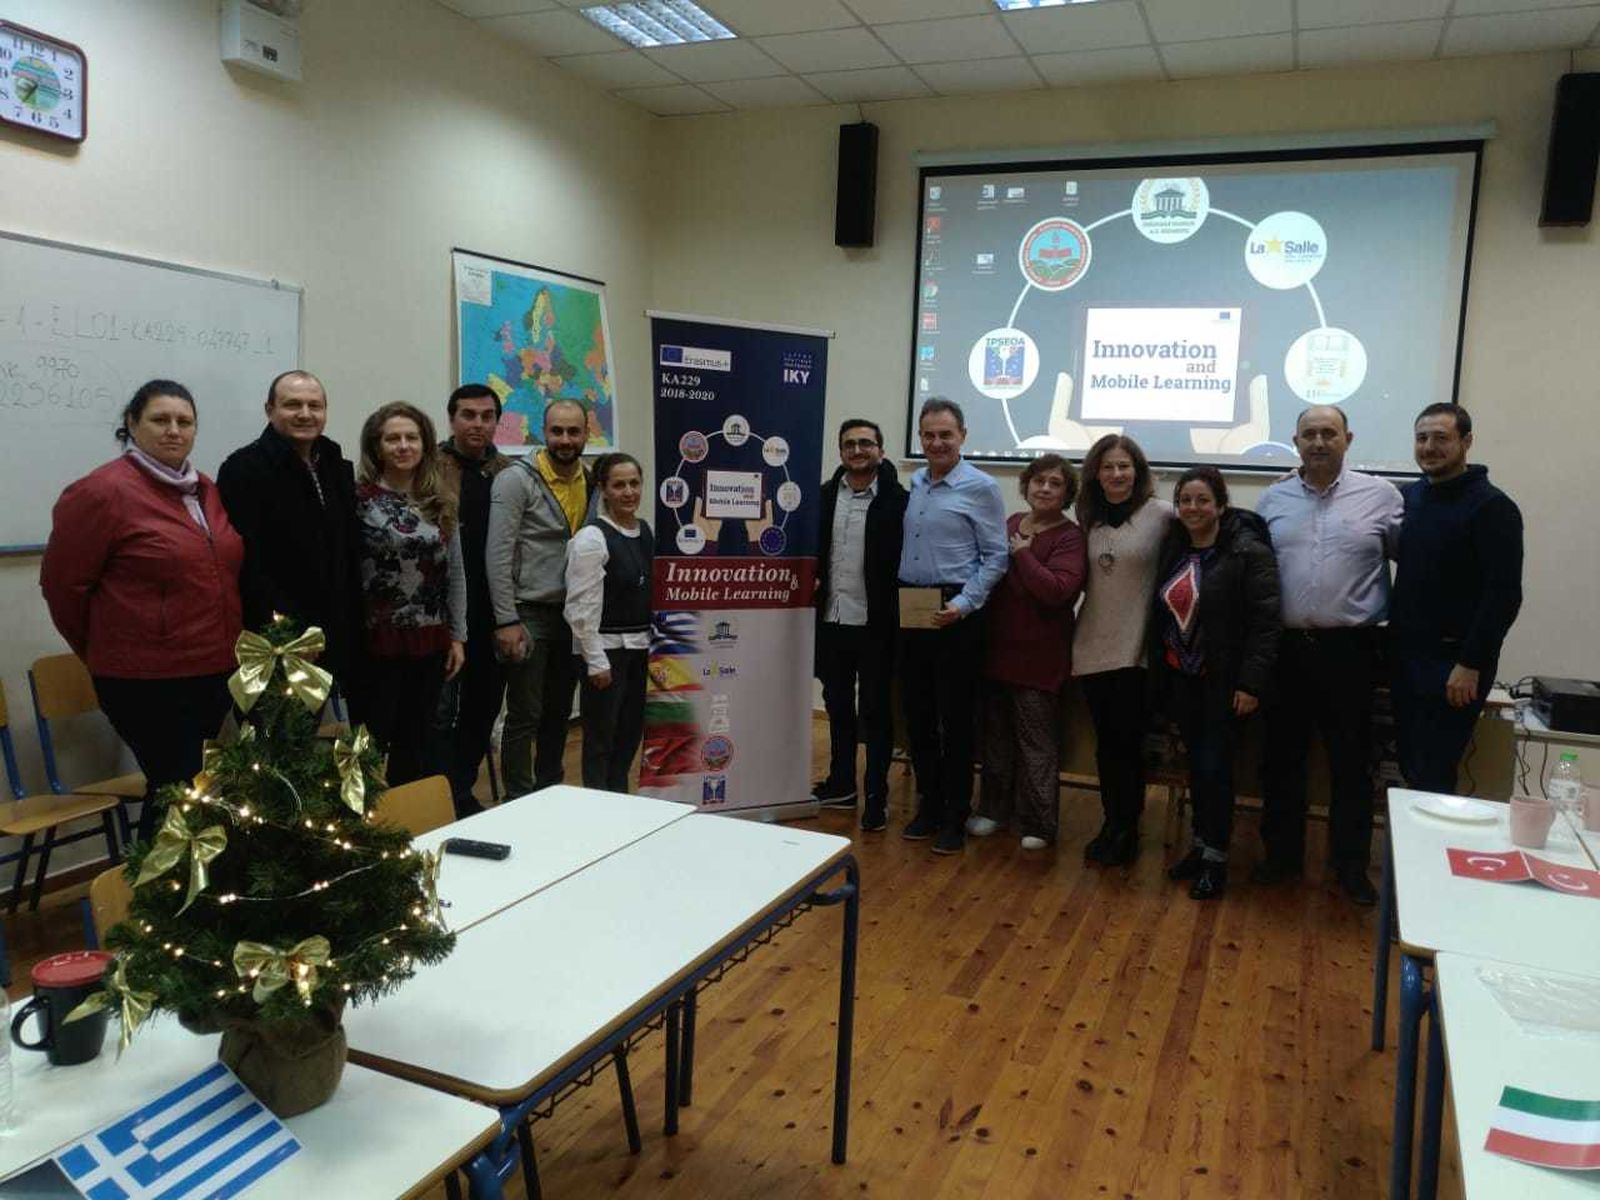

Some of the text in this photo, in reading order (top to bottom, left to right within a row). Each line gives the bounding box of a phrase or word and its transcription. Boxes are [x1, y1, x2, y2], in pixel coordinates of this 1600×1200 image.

[13, 37, 23, 50] 11
[31, 42, 44, 57] 12
[63, 68, 73, 81] 2
[62, 87, 73, 101] 3
[14, 105, 22, 119] 7
[31, 111, 42, 124] 6
[62, 107, 72, 121] 4
[49, 116, 59, 129] 5
[1249, 239, 1320, 255] La Salle
[1093, 340, 1217, 360] Innovation
[1186, 361, 1216, 374] and
[661, 373, 701, 386] KA229
[783, 369, 810, 384] IKY
[1091, 375, 1232, 393] Mobile Learning
[660, 387, 715, 401] 2018-2020
[666, 562, 800, 590] Innovation &
[666, 587, 790, 603] Mobile Learning
